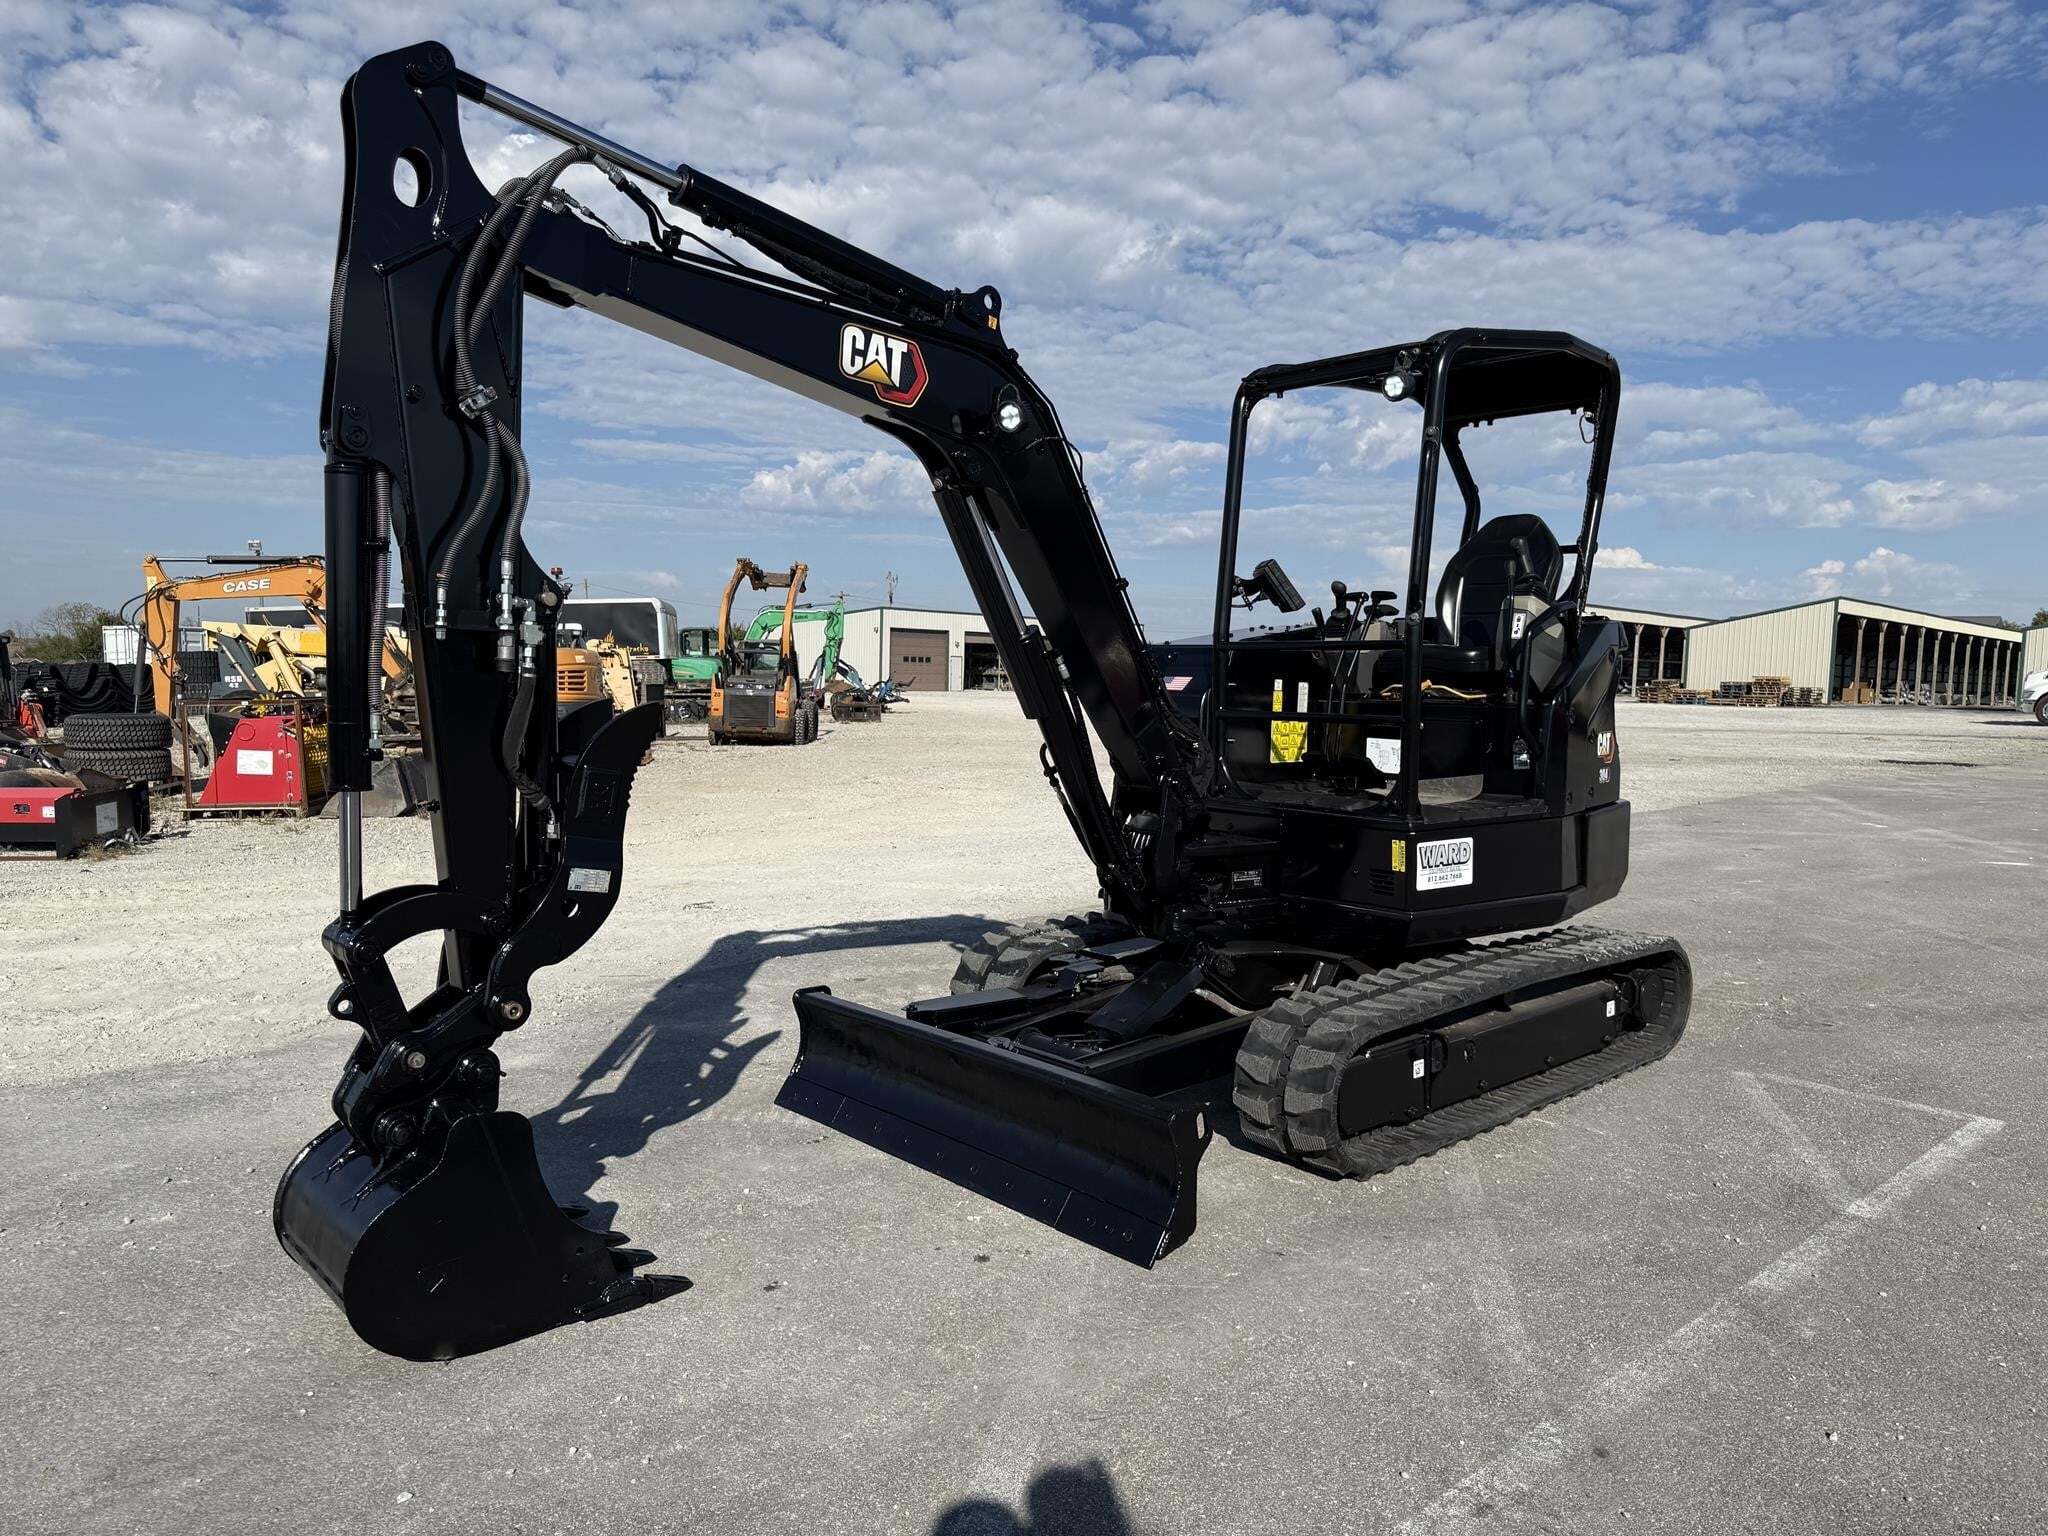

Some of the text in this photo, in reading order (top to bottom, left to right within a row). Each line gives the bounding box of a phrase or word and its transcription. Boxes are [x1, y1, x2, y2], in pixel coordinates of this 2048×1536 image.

[842, 326, 908, 388] CAT
[223, 578, 271, 593] CASE
[1597, 732, 1612, 756] CAT
[1419, 842, 1472, 869] WARD
